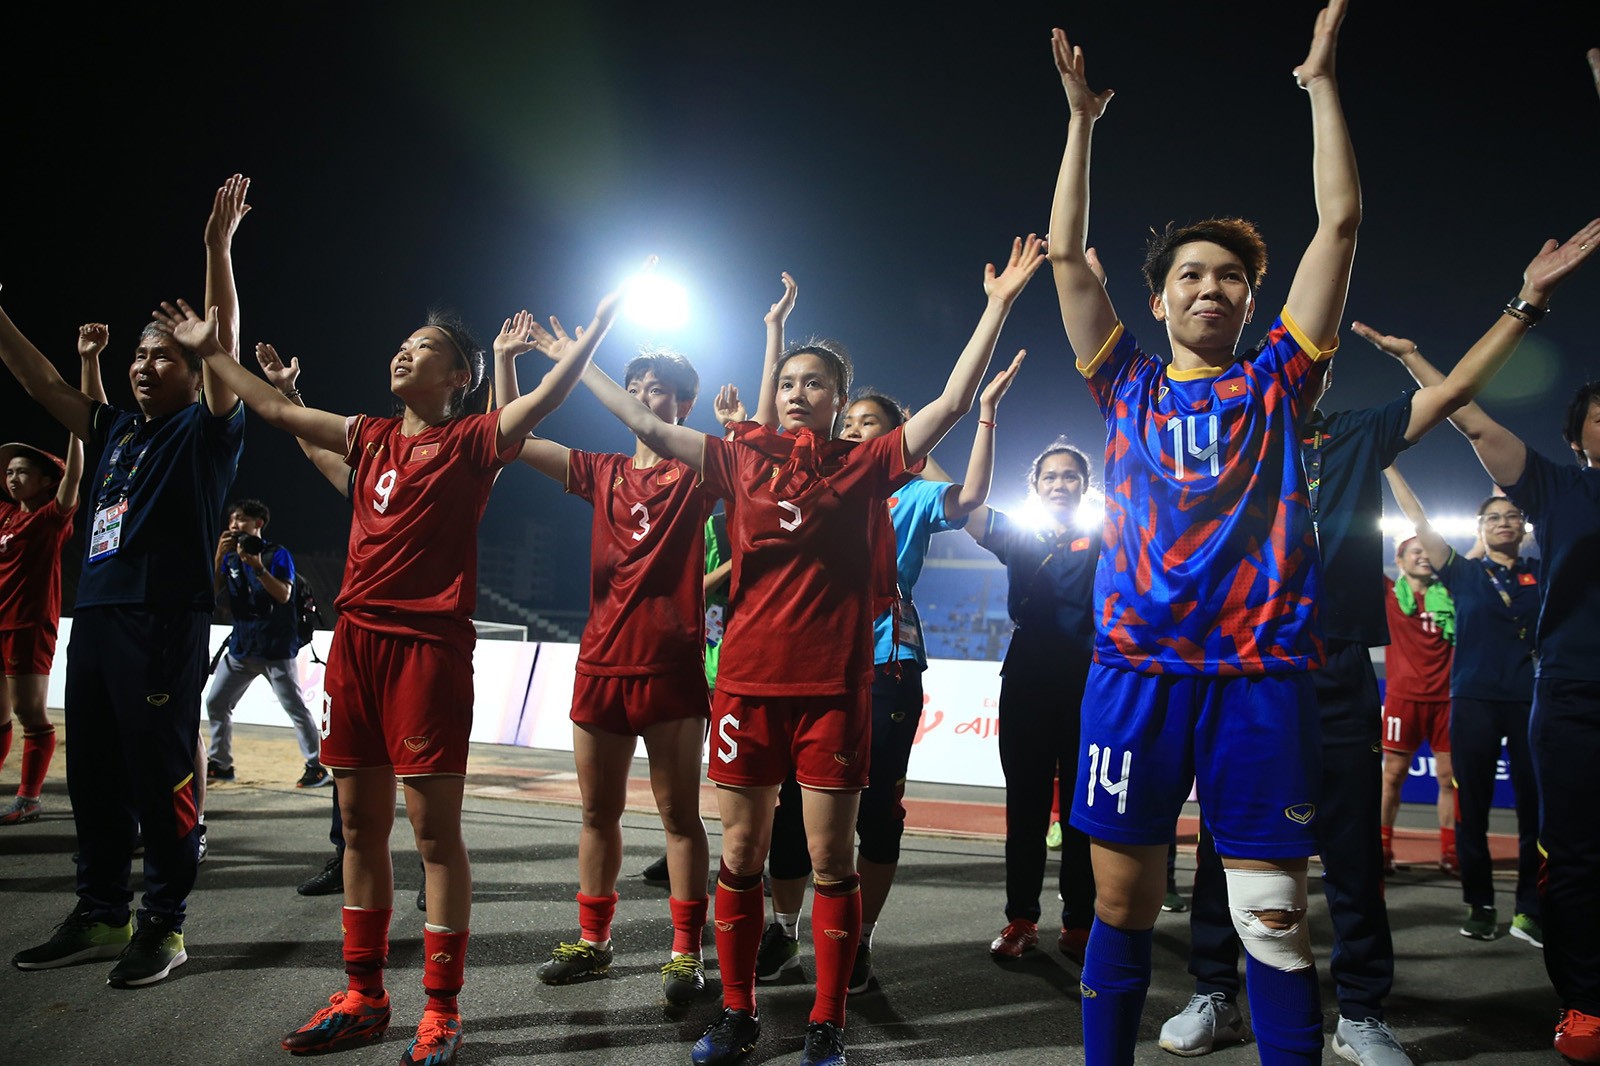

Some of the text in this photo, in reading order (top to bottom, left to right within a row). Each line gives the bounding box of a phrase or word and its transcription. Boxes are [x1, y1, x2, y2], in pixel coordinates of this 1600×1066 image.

[1167, 415, 1219, 480] 14
[373, 469, 397, 514] 9
[631, 502, 650, 541] 3
[1387, 716, 1401, 742] 11
[1088, 743, 1132, 815] 14
